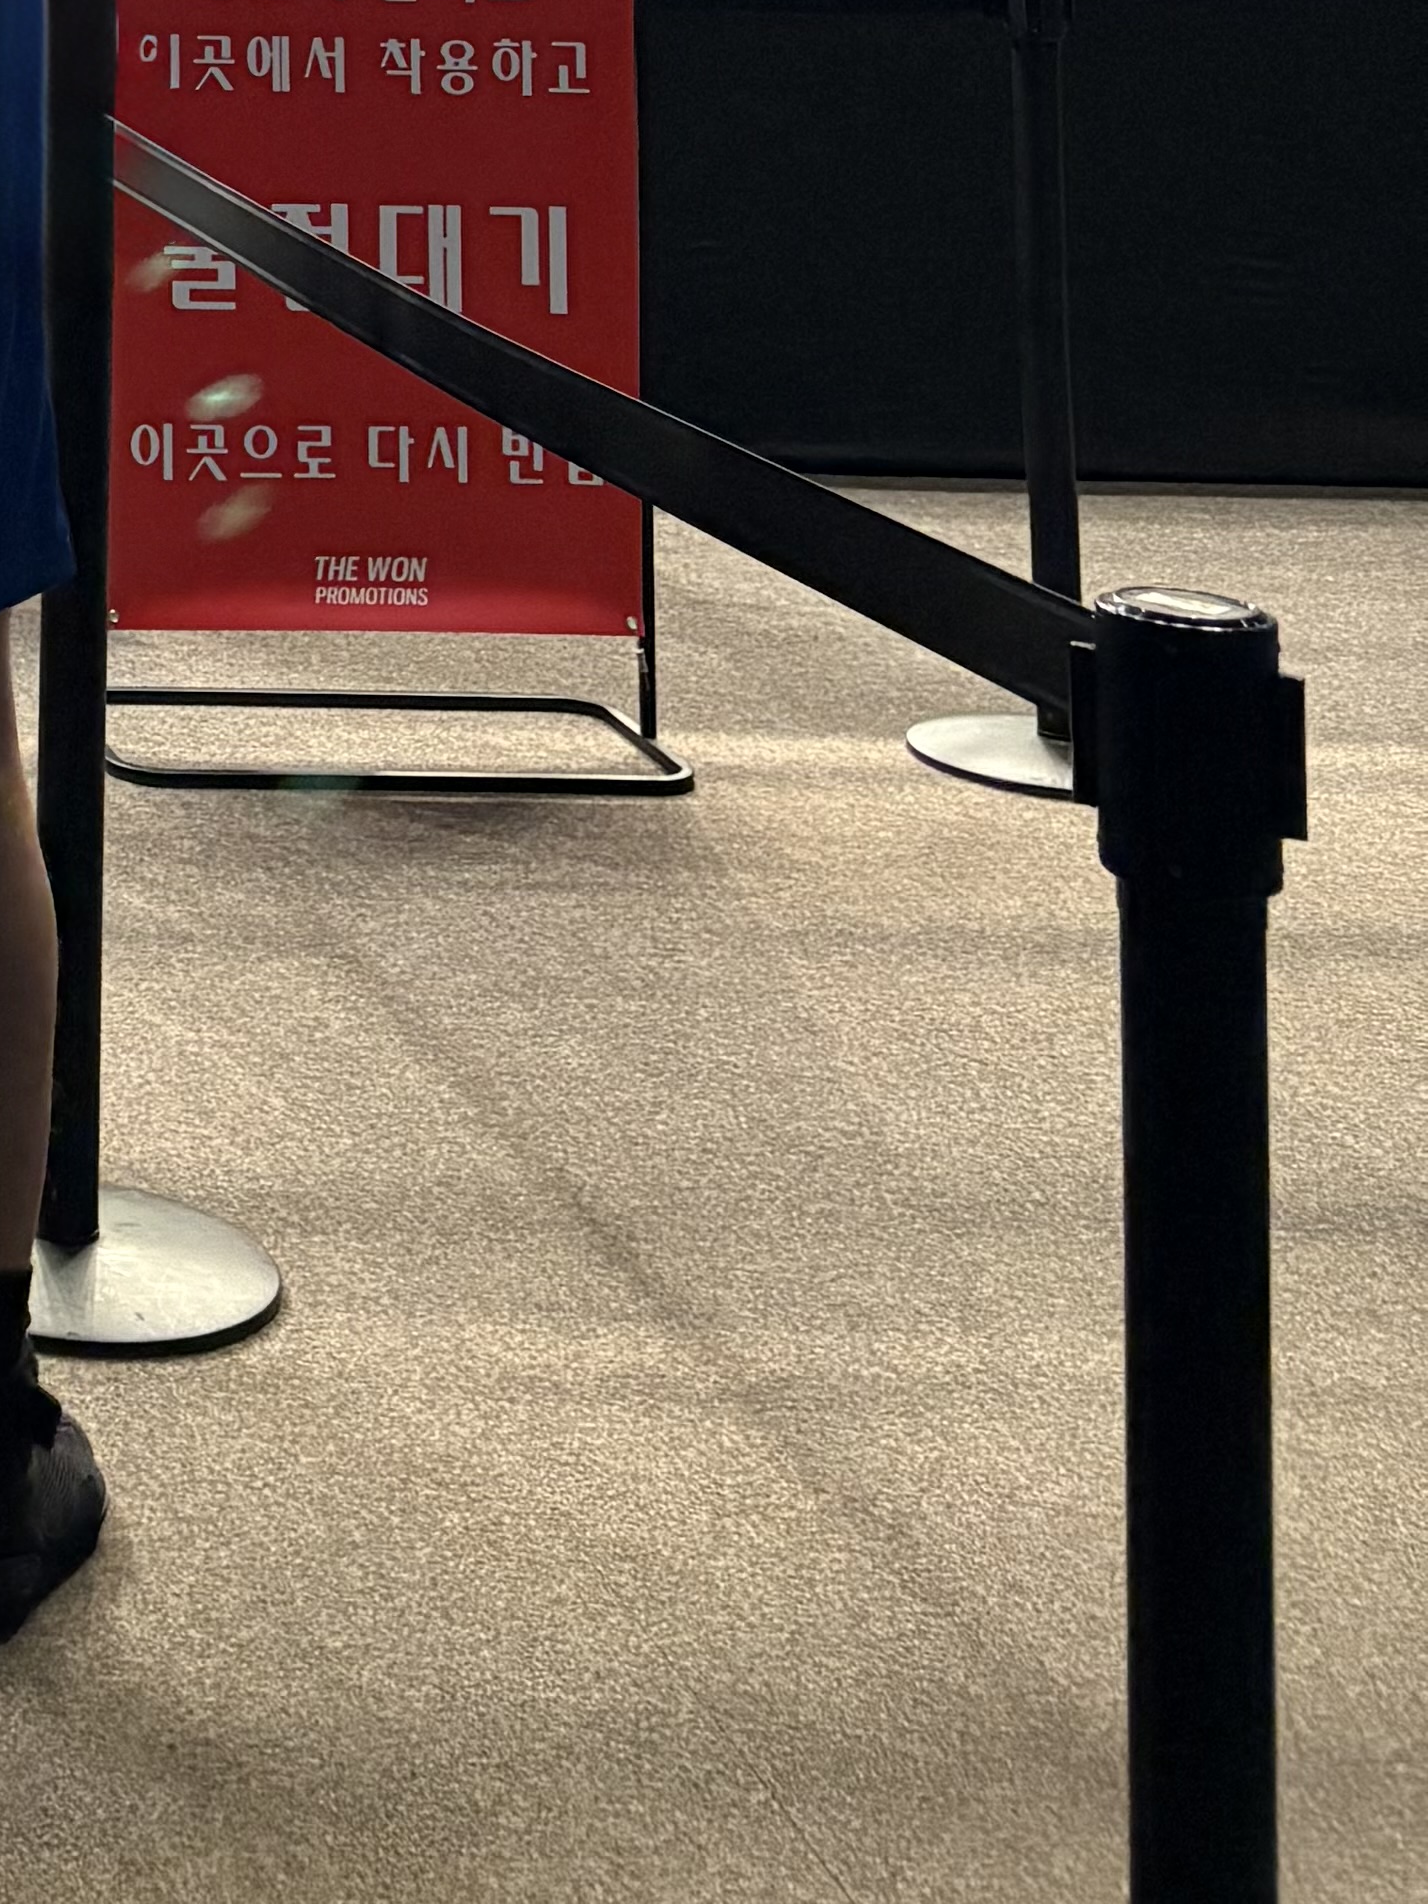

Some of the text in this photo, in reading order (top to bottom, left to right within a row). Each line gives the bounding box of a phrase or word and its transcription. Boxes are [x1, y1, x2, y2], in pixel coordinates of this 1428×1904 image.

[139, 33, 591, 97] 이곳에서 착용하고
[130, 422, 336, 481] 이곳으로
[368, 425, 469, 484] 다시
[314, 555, 428, 583] THE WON
[314, 586, 428, 606] PROMOTIONS
